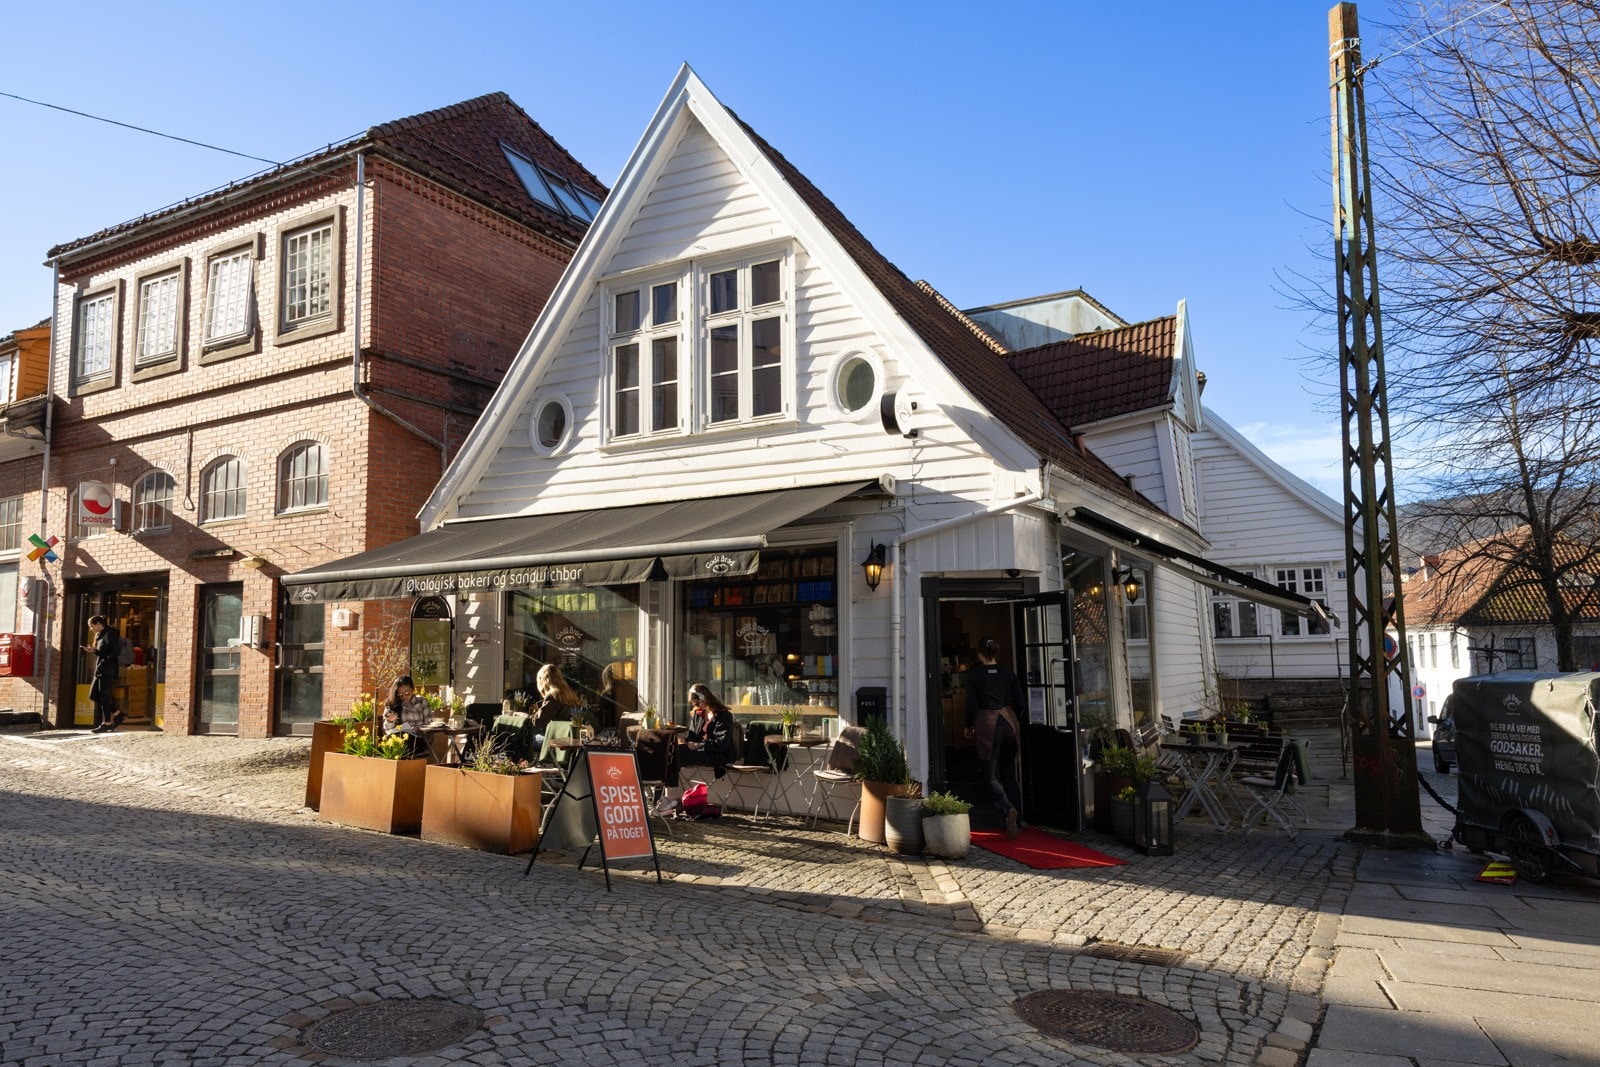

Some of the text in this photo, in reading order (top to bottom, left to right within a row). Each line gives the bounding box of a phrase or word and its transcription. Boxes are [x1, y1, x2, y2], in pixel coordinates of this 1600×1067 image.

[82, 516, 112, 524] posten
[406, 566, 582, 593] Økologisk bakeri og sandwichbar
[417, 642, 445, 654] LIVET
[1499, 723, 1506, 732] ER
[1507, 723, 1515, 732] PÅ
[1516, 724, 1526, 733] VEI
[1526, 725, 1540, 734] MED
[1490, 740, 1544, 757] GODSAKER.
[1494, 759, 1514, 772] HENG
[1515, 762, 1530, 774] DEG
[600, 785, 638, 804] SPISE
[604, 805, 640, 825] GODT
[607, 825, 644, 839] PÅ TOGET
